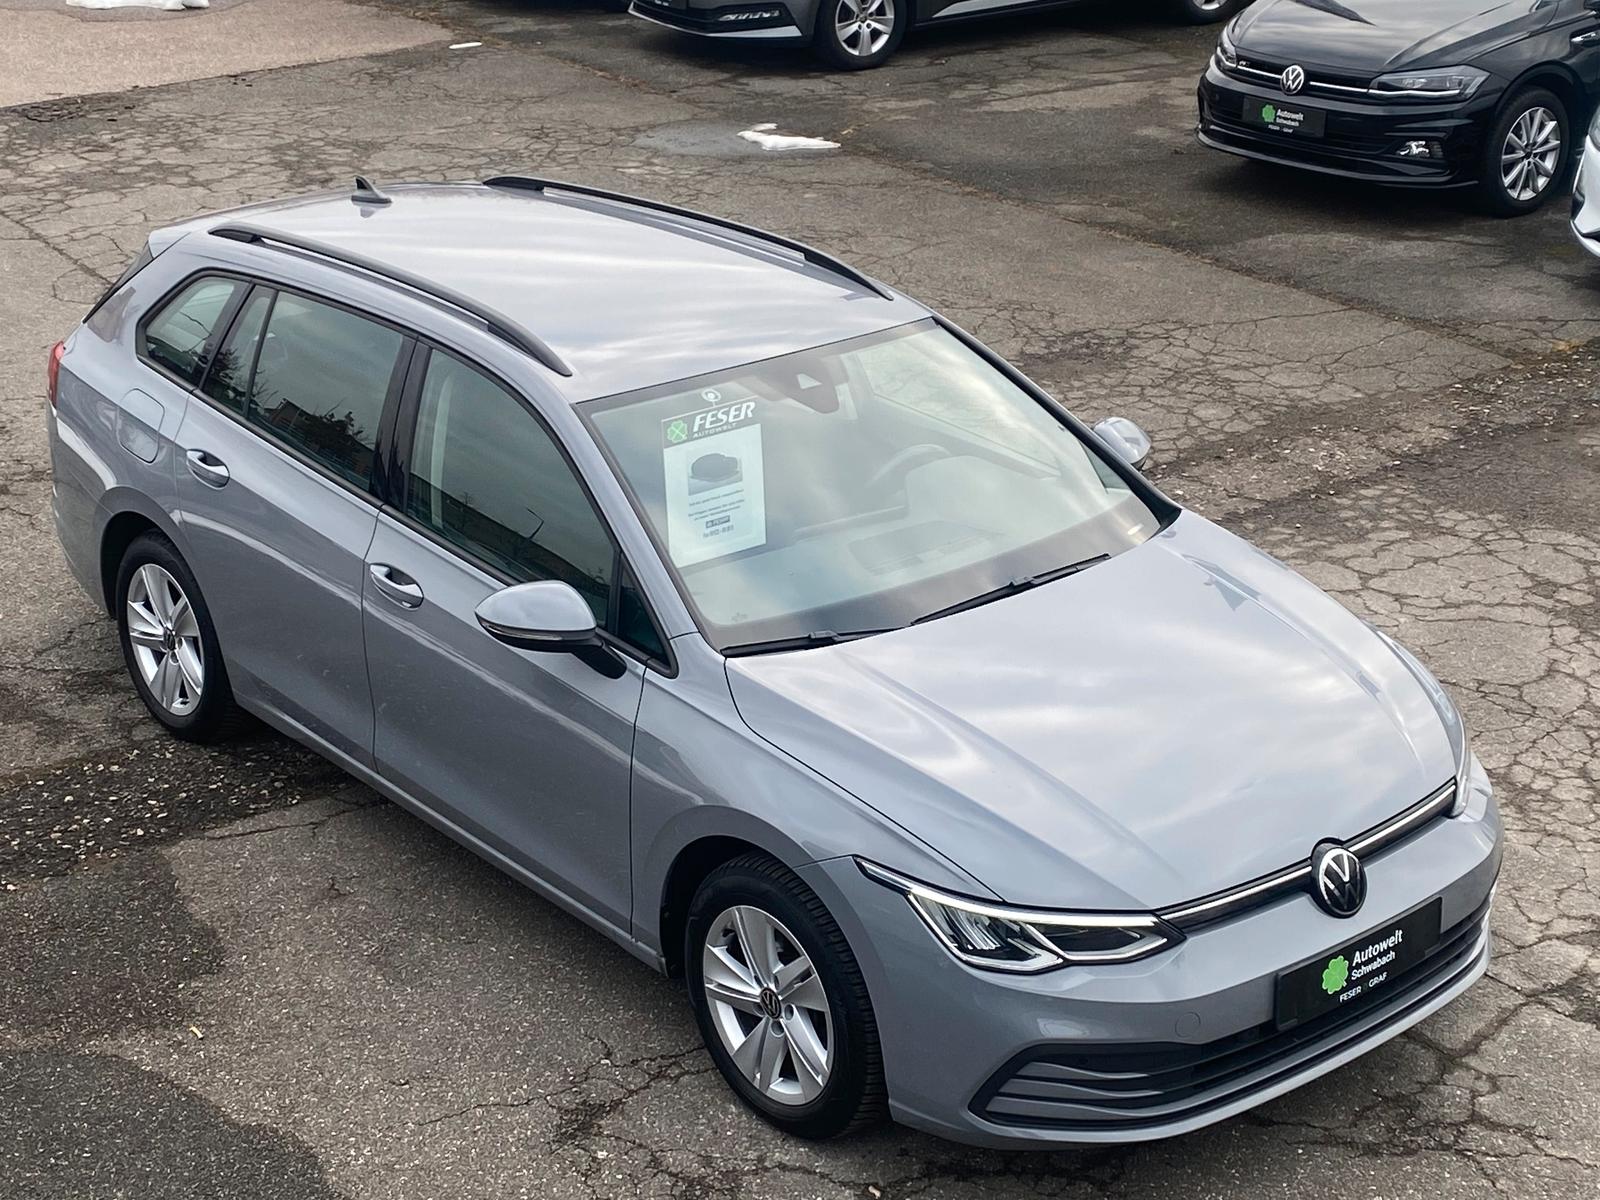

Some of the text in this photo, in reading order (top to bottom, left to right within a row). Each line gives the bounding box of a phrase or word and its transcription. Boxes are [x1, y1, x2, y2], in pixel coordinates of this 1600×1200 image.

[693, 401, 755, 433] FESER
[1352, 929, 1403, 967] Autowelt
[1351, 950, 1396, 980] Schwabach
[1340, 971, 1388, 1003] FESER GRAF
